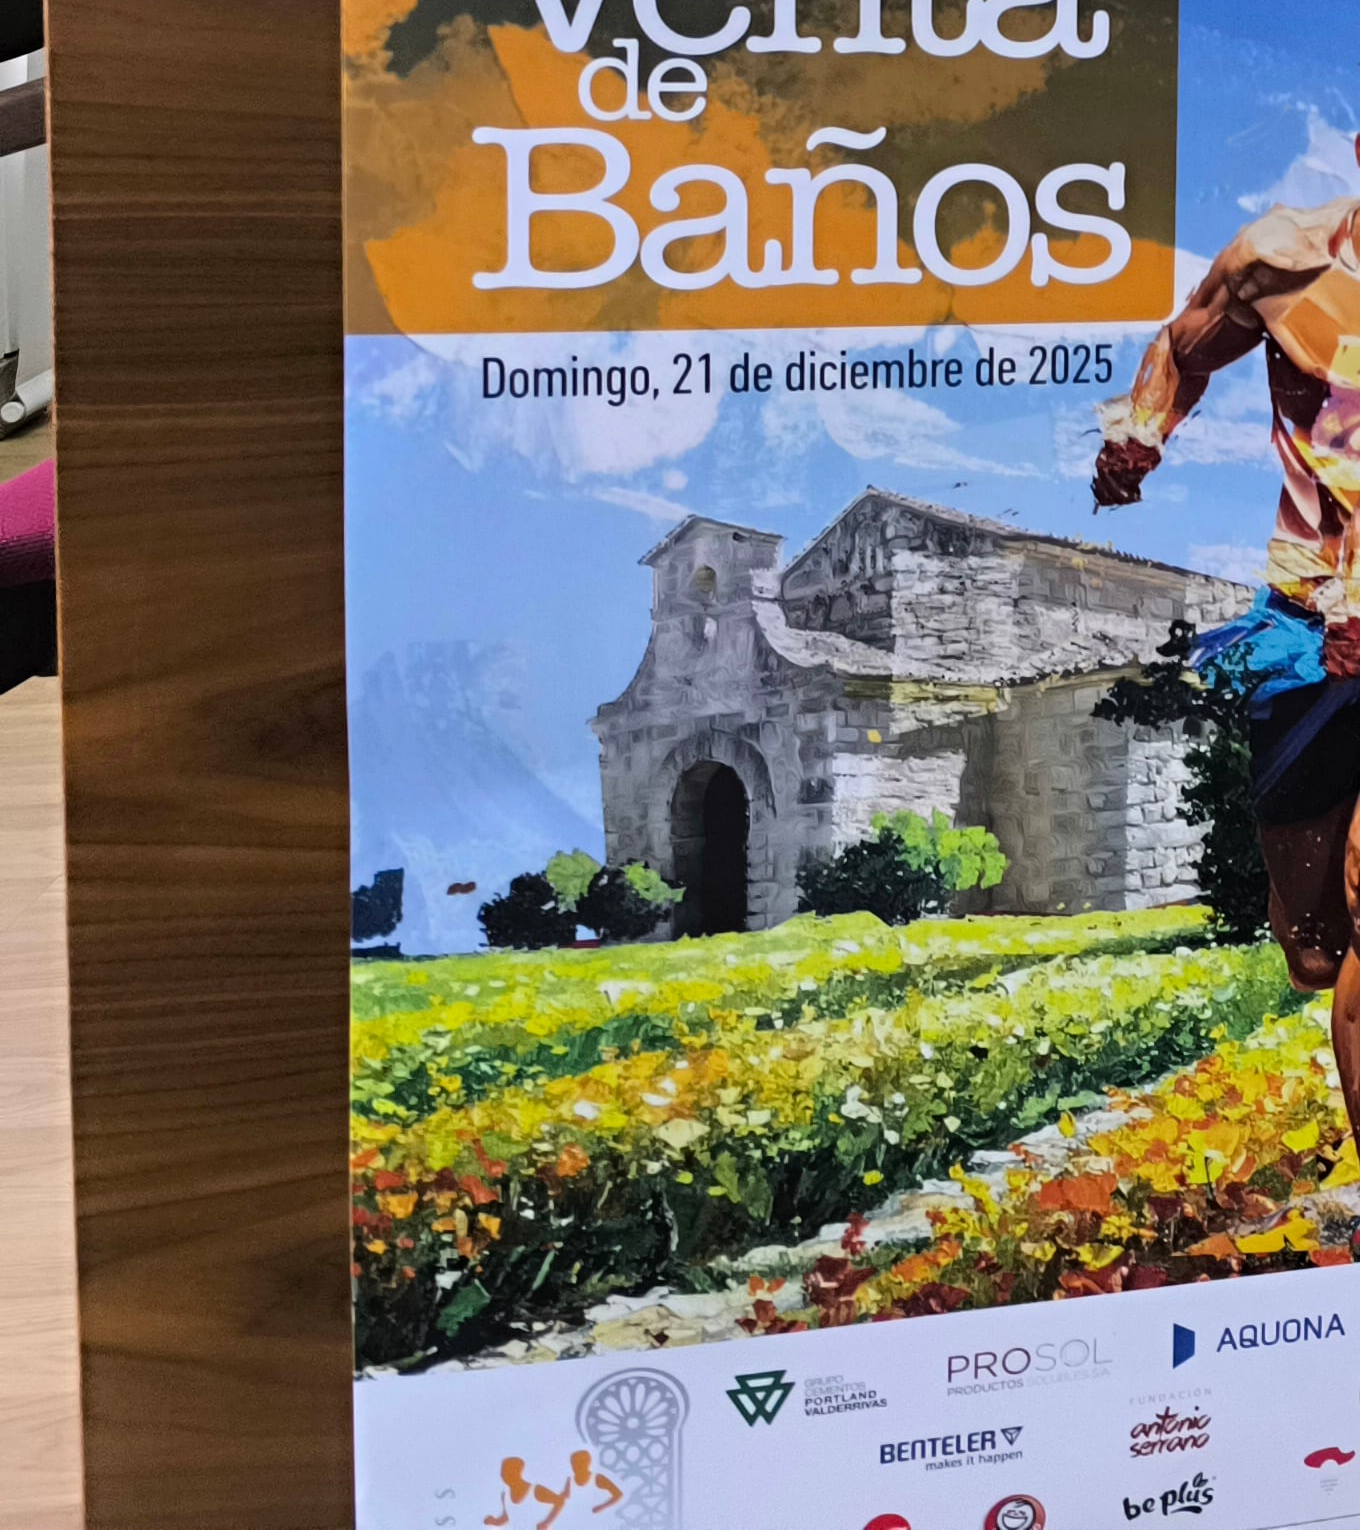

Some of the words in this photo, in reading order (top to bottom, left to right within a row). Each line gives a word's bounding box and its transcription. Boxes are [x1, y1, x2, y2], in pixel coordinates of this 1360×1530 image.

[577, 37, 708, 123] de
[472, 126, 1134, 291] Baños
[481, 357, 661, 402] Domingo,
[671, 352, 713, 395] 21
[730, 350, 773, 394] de
[783, 347, 970, 392] diciembre
[974, 347, 1018, 388] de
[1027, 343, 1113, 387] 2025
[1216, 1313, 1346, 1354] AQUONA
[947, 1337, 1113, 1383] PROSOL
[804, 1375, 844, 1388] GRUPO
[804, 1381, 866, 1397] CEMENTOS
[947, 1378, 1024, 1397] PRODUCTOS
[804, 1390, 877, 1407] PORTLAND
[804, 1398, 888, 1417] VALDERRIVAS
[1130, 1406, 1211, 1439] antonio
[880, 1430, 996, 1465] BENTELER
[1130, 1433, 1210, 1458] serrano
[925, 1456, 963, 1471] makes
[966, 1453, 975, 1466] it
[978, 1449, 1023, 1467] happen
[1123, 1497, 1155, 1521] be
